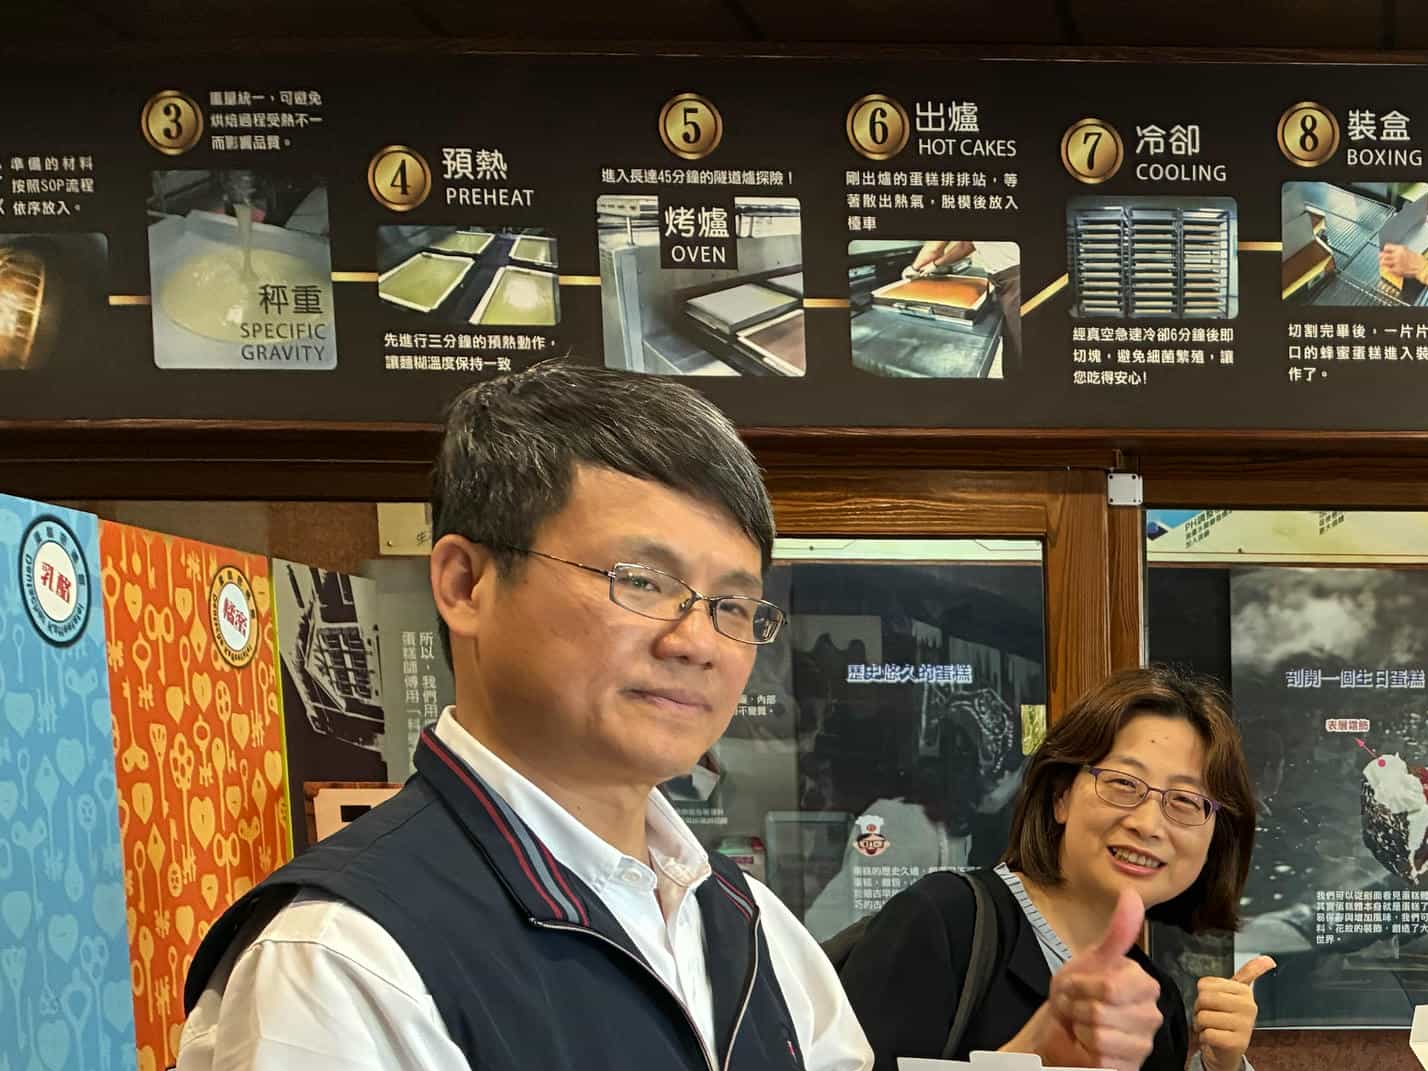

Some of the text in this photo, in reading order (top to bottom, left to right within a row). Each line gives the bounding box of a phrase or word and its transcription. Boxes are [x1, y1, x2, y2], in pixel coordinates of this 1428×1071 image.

[162, 102, 183, 139] 3
[682, 107, 701, 145] 5
[869, 107, 889, 145] 6
[915, 101, 980, 132] 出爐
[1347, 110, 1411, 142] 裝盒
[919, 139, 1017, 157] HOT CAKES
[1135, 124, 1201, 156] 冷卻
[1299, 114, 1319, 153] 8
[441, 147, 508, 180] 預熱
[1082, 132, 1102, 171] 7
[1347, 149, 1423, 166] BOXING
[390, 159, 411, 197] 4
[1136, 164, 1228, 182] COOLING
[446, 187, 535, 207] PREHEAT
[664, 206, 730, 238] 烤爐
[671, 245, 726, 263] OVEN
[259, 284, 324, 316] 秤重
[240, 323, 326, 340] SPECIFIC
[241, 345, 326, 361] GRAVITY
[1073, 370, 1147, 385] 您吃得安心!
[1288, 367, 1328, 382] 作了。
[847, 664, 973, 684] 歷史悠久的蛋糕
[1286, 668, 1425, 689] 剖開一個生日蛋糕
